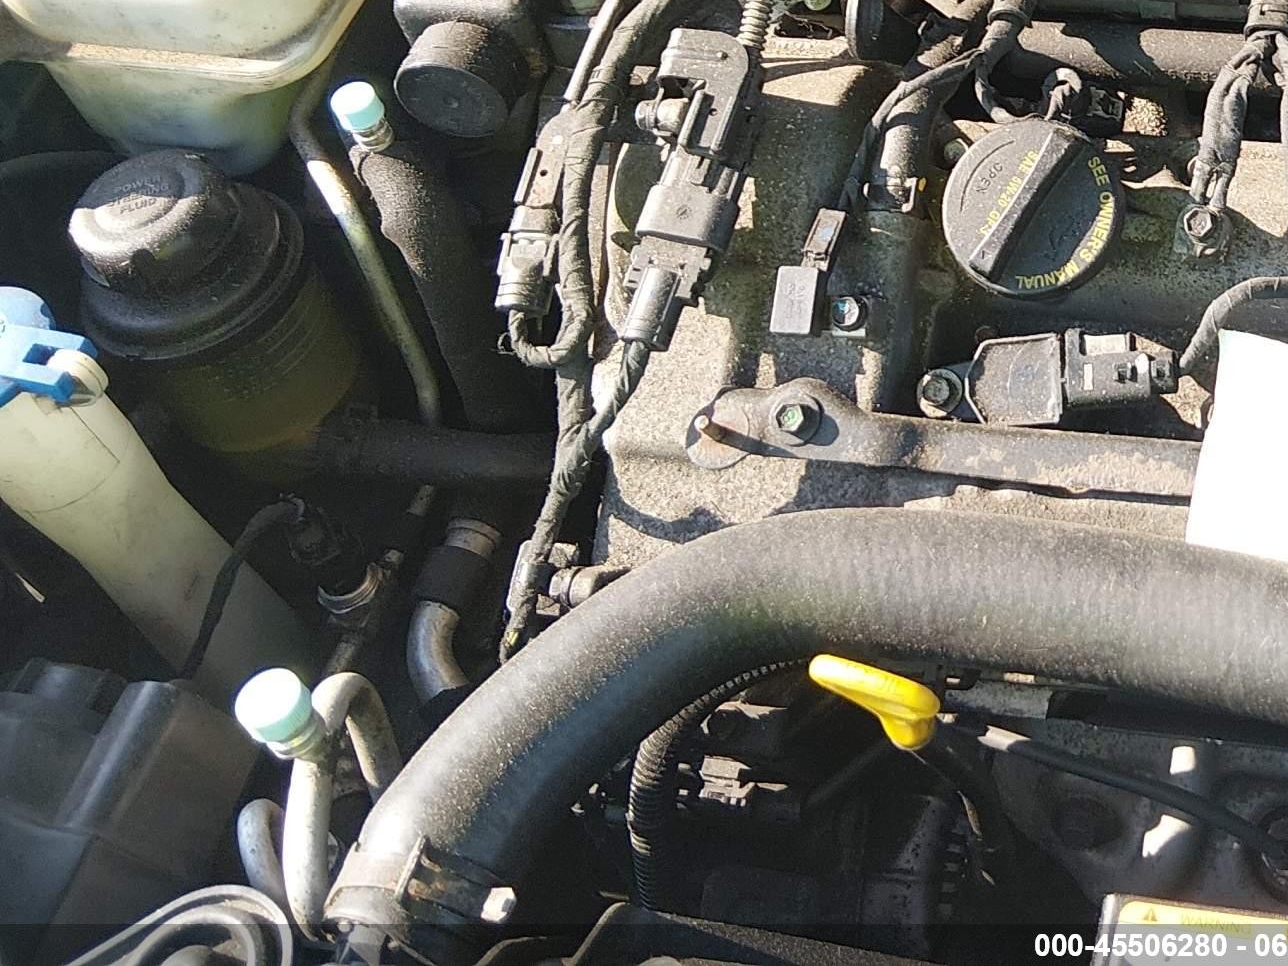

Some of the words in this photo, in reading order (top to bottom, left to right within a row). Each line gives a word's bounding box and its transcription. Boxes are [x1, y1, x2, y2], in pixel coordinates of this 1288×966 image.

[1018, 148, 1039, 173] SAE
[1088, 157, 1109, 186] SEE
[976, 162, 1003, 195] OPEN
[119, 197, 157, 215] FLUID
[1016, 259, 1079, 290] MANUAL
